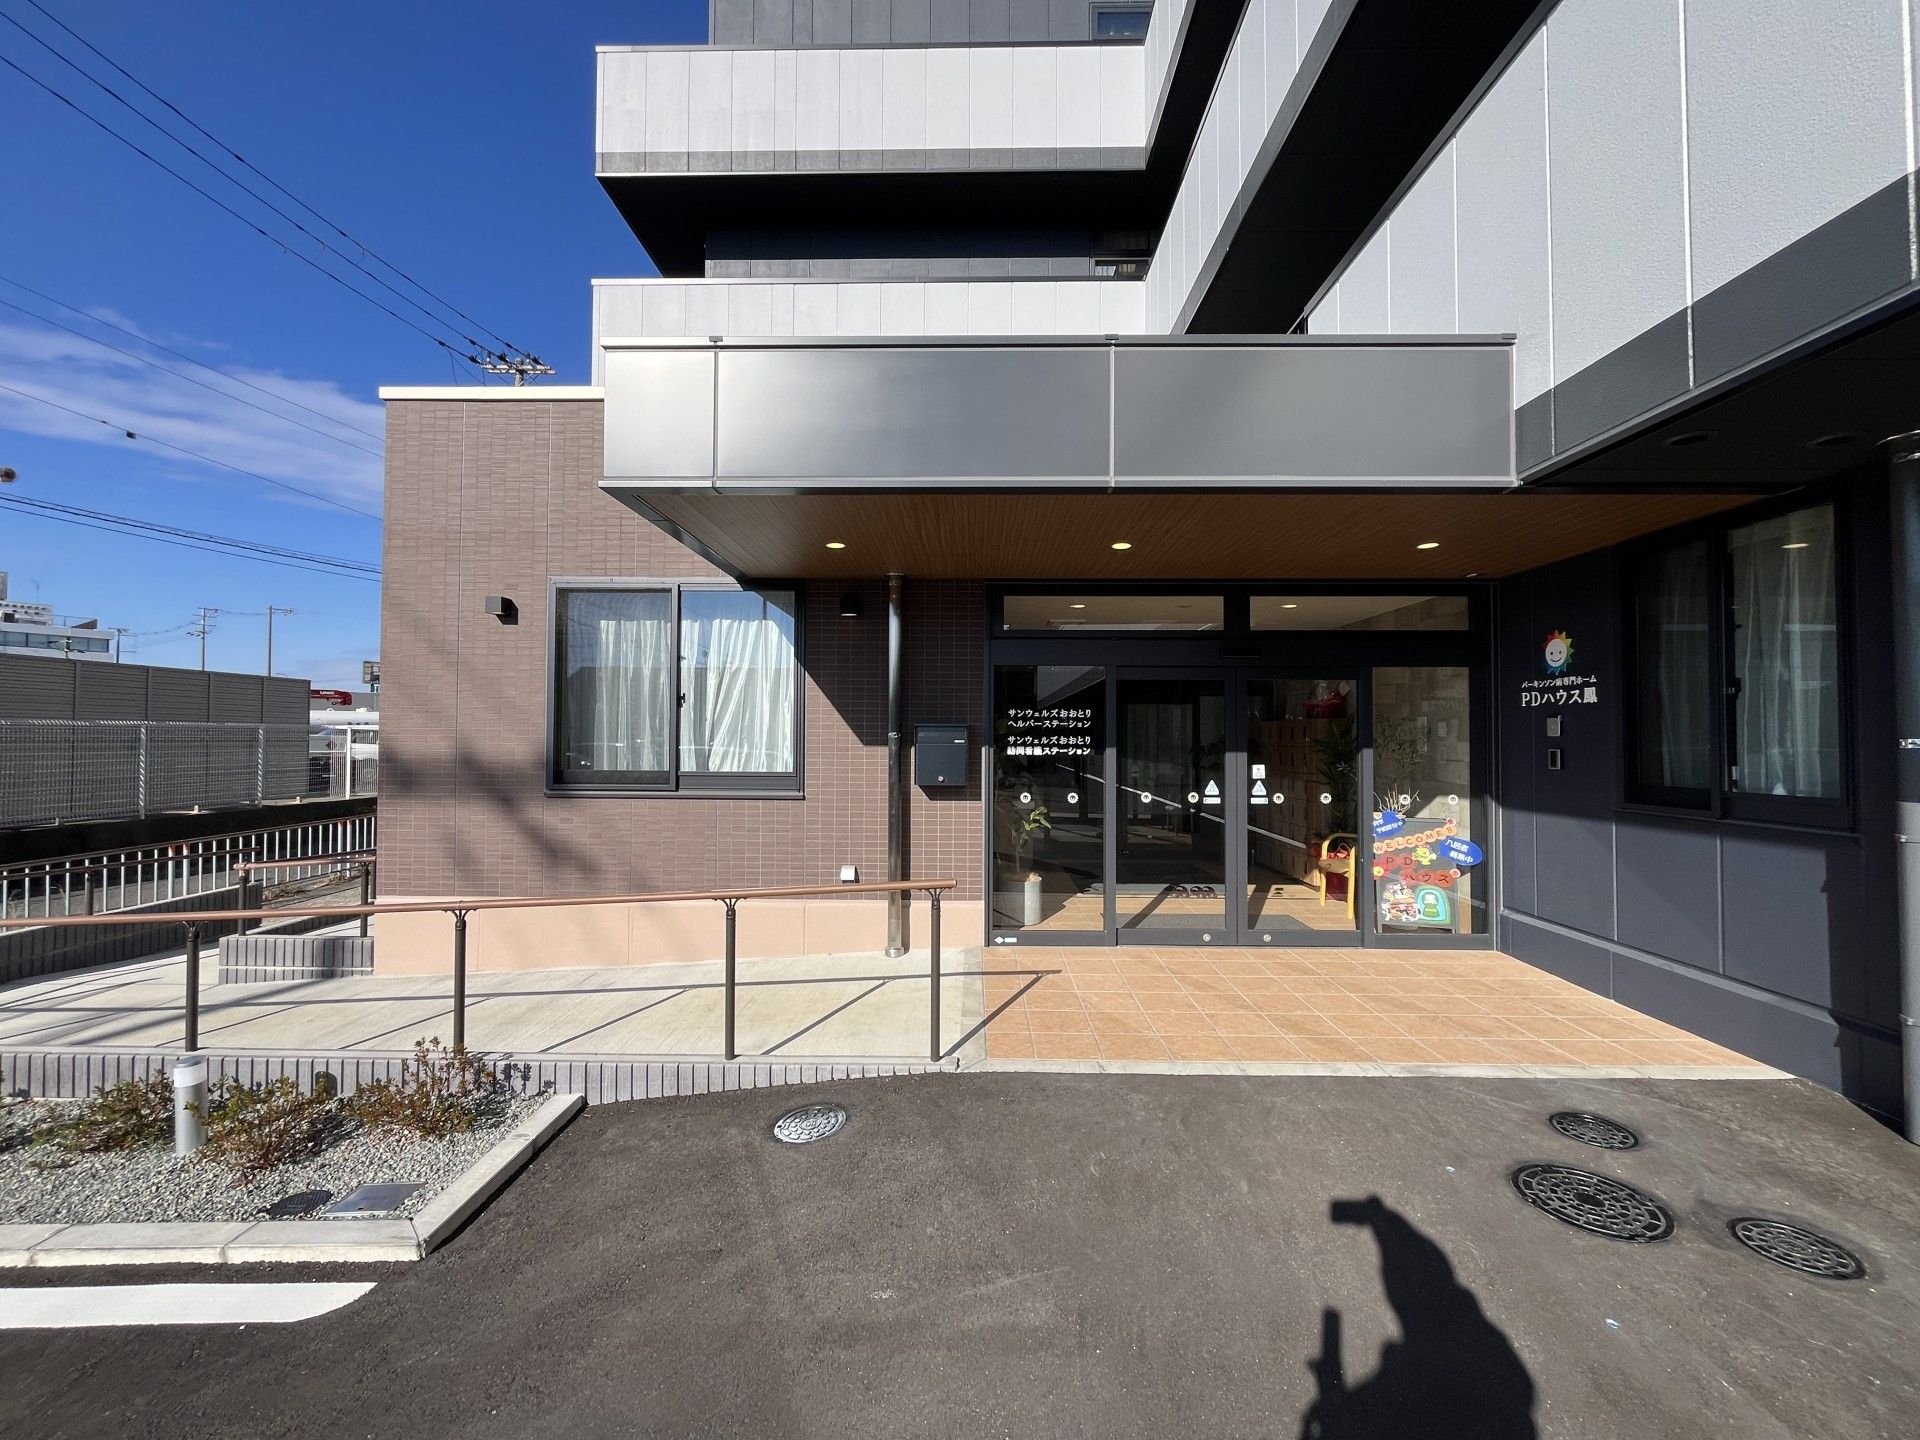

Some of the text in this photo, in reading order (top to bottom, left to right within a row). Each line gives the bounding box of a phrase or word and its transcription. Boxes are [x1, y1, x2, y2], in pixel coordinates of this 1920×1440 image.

[1521, 687, 1598, 707] PDハウス鳳
[1008, 709, 1091, 718] サンウェルズおおとり
[1008, 736, 1091, 744] サンウェルズおおとり
[1386, 857, 1413, 865] PD
[1405, 874, 1449, 883] ハウス
